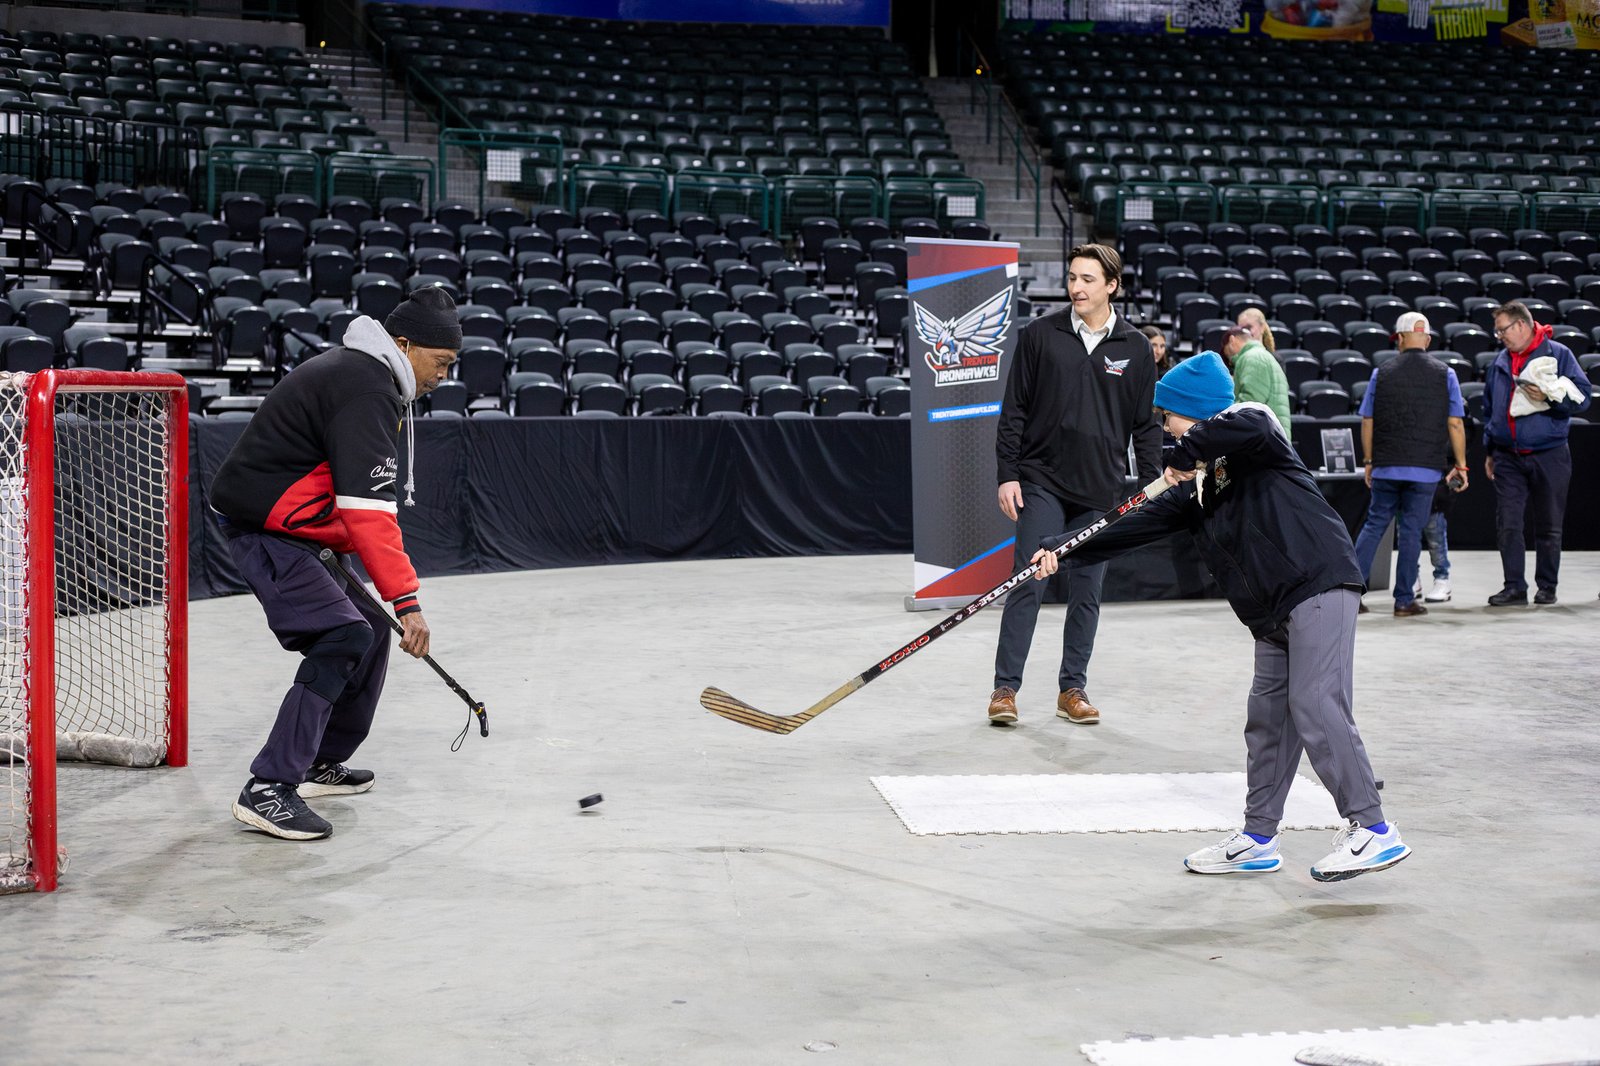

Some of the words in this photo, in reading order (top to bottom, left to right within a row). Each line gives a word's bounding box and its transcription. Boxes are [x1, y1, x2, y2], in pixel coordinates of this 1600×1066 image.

[1407, 0, 1429, 29] YOU
[1431, 6, 1487, 40] THROW
[939, 365, 997, 383] IRONHAWKS
[962, 354, 998, 367] TRENTON
[879, 635, 930, 671] KOHO
